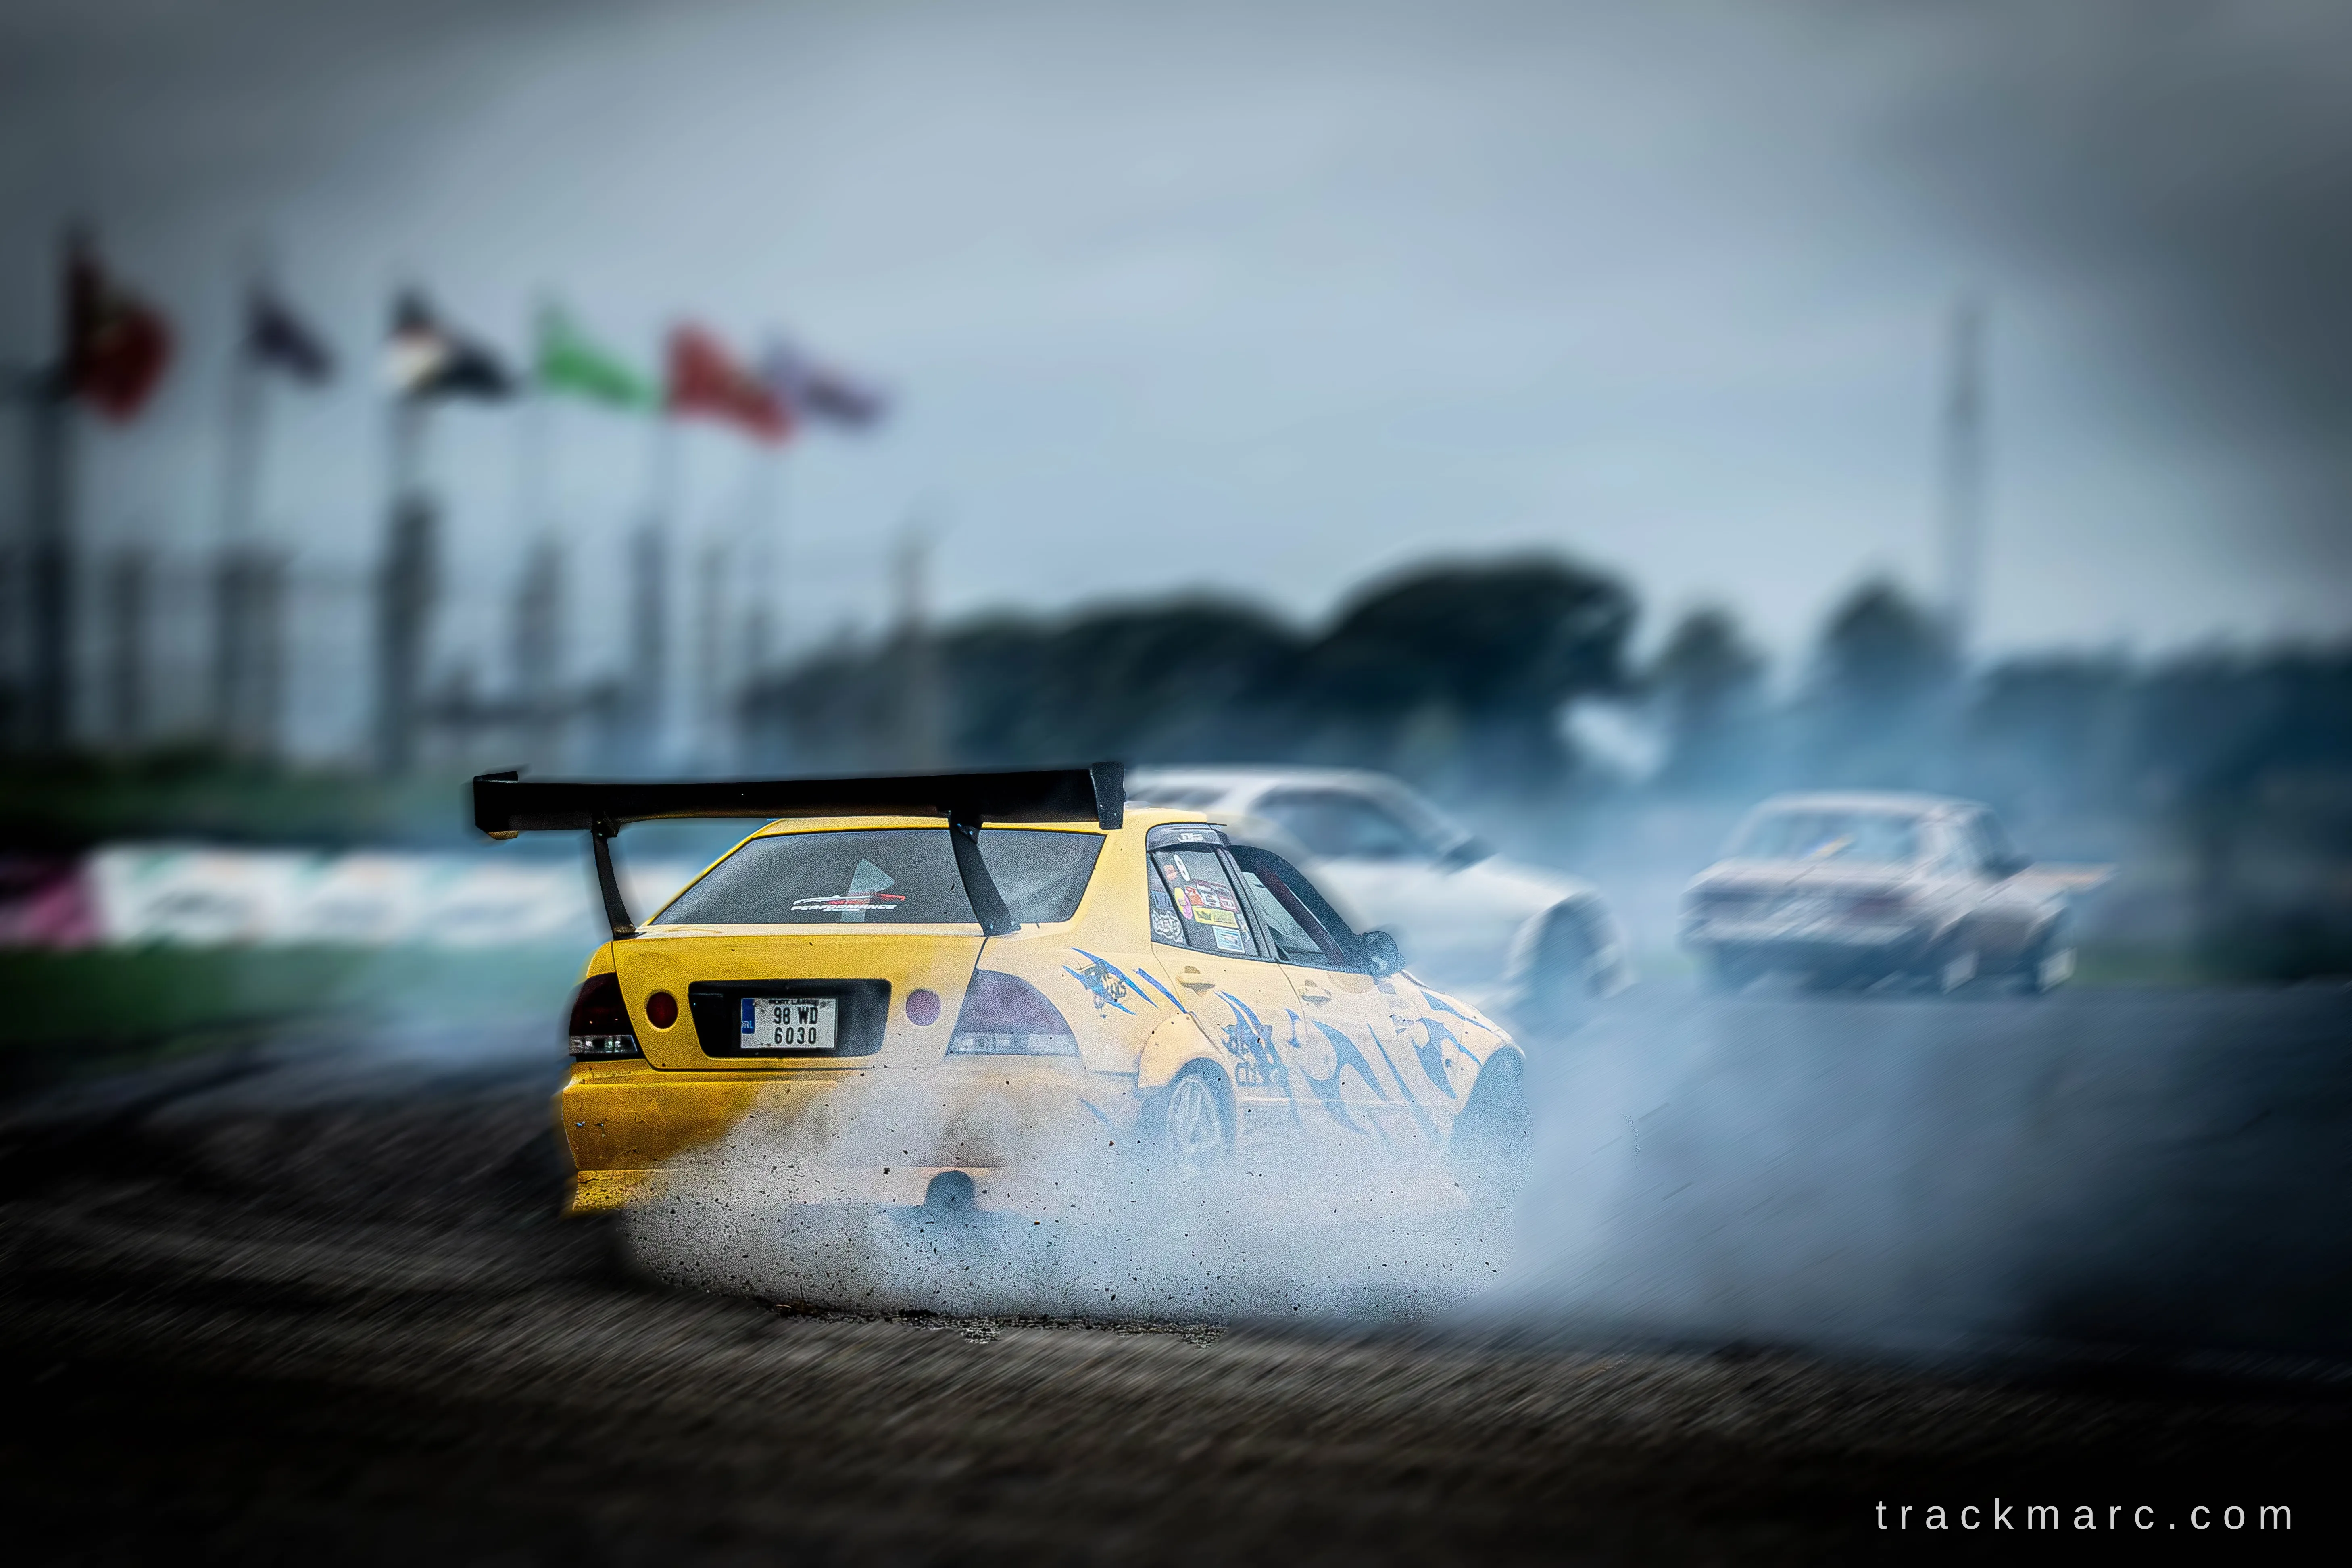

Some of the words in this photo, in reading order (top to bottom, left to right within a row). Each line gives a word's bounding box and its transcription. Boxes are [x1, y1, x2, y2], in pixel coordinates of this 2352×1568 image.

[774, 1007, 790, 1025] 98
[797, 1006, 818, 1025] WD
[774, 1027, 817, 1044] 6030
